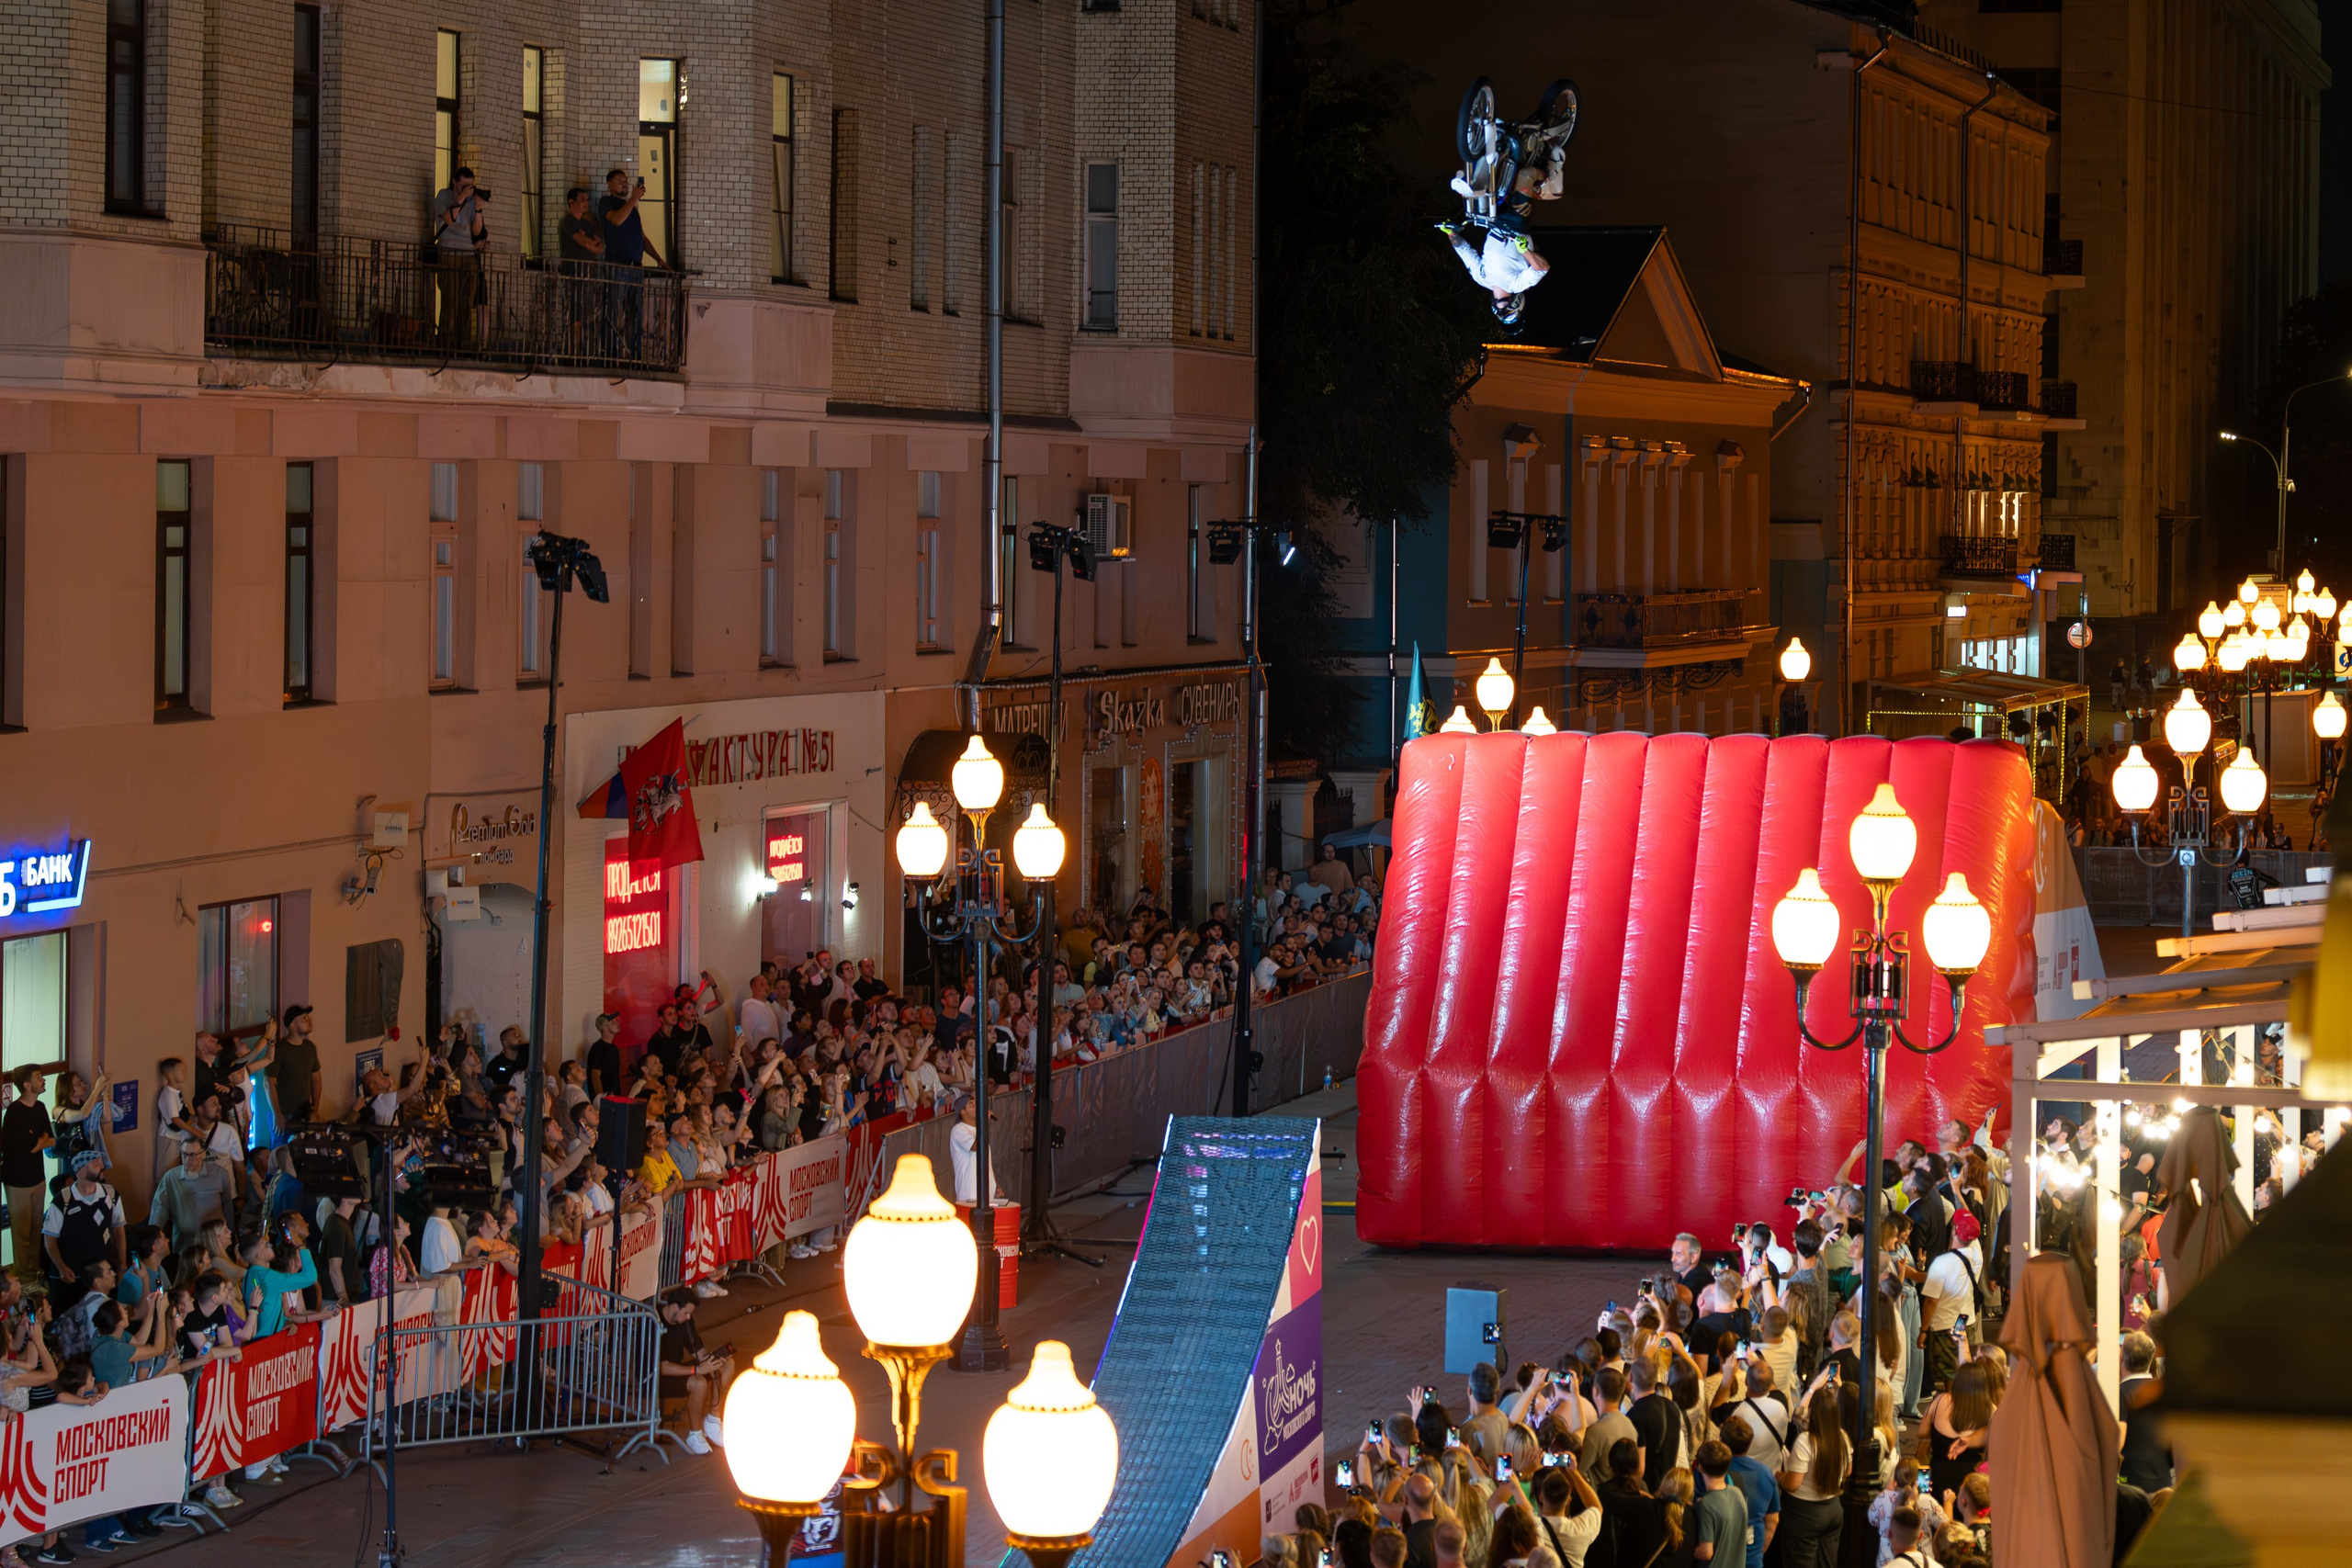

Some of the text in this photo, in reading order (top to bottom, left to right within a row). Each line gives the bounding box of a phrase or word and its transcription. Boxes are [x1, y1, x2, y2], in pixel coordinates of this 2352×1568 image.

[995, 701, 1068, 743] МАТРЕШИ
[1182, 682, 1243, 726] СУВЕНИРЫ
[454, 804, 535, 844] Premium Gold
[27, 853, 74, 886] БАНК
[607, 911, 661, 953] 89265121501
[789, 1150, 840, 1195] МОСКОВСКИЙ
[789, 1191, 813, 1223] СПОРТ
[247, 1337, 314, 1403] МОСКОВСКИЙ
[1289, 1369, 1316, 1413] НОЧЬ
[56, 1399, 170, 1466] МОСКОВСКИЙ
[246, 1396, 280, 1441] СПОРТ
[54, 1457, 109, 1505] СПОРТ
